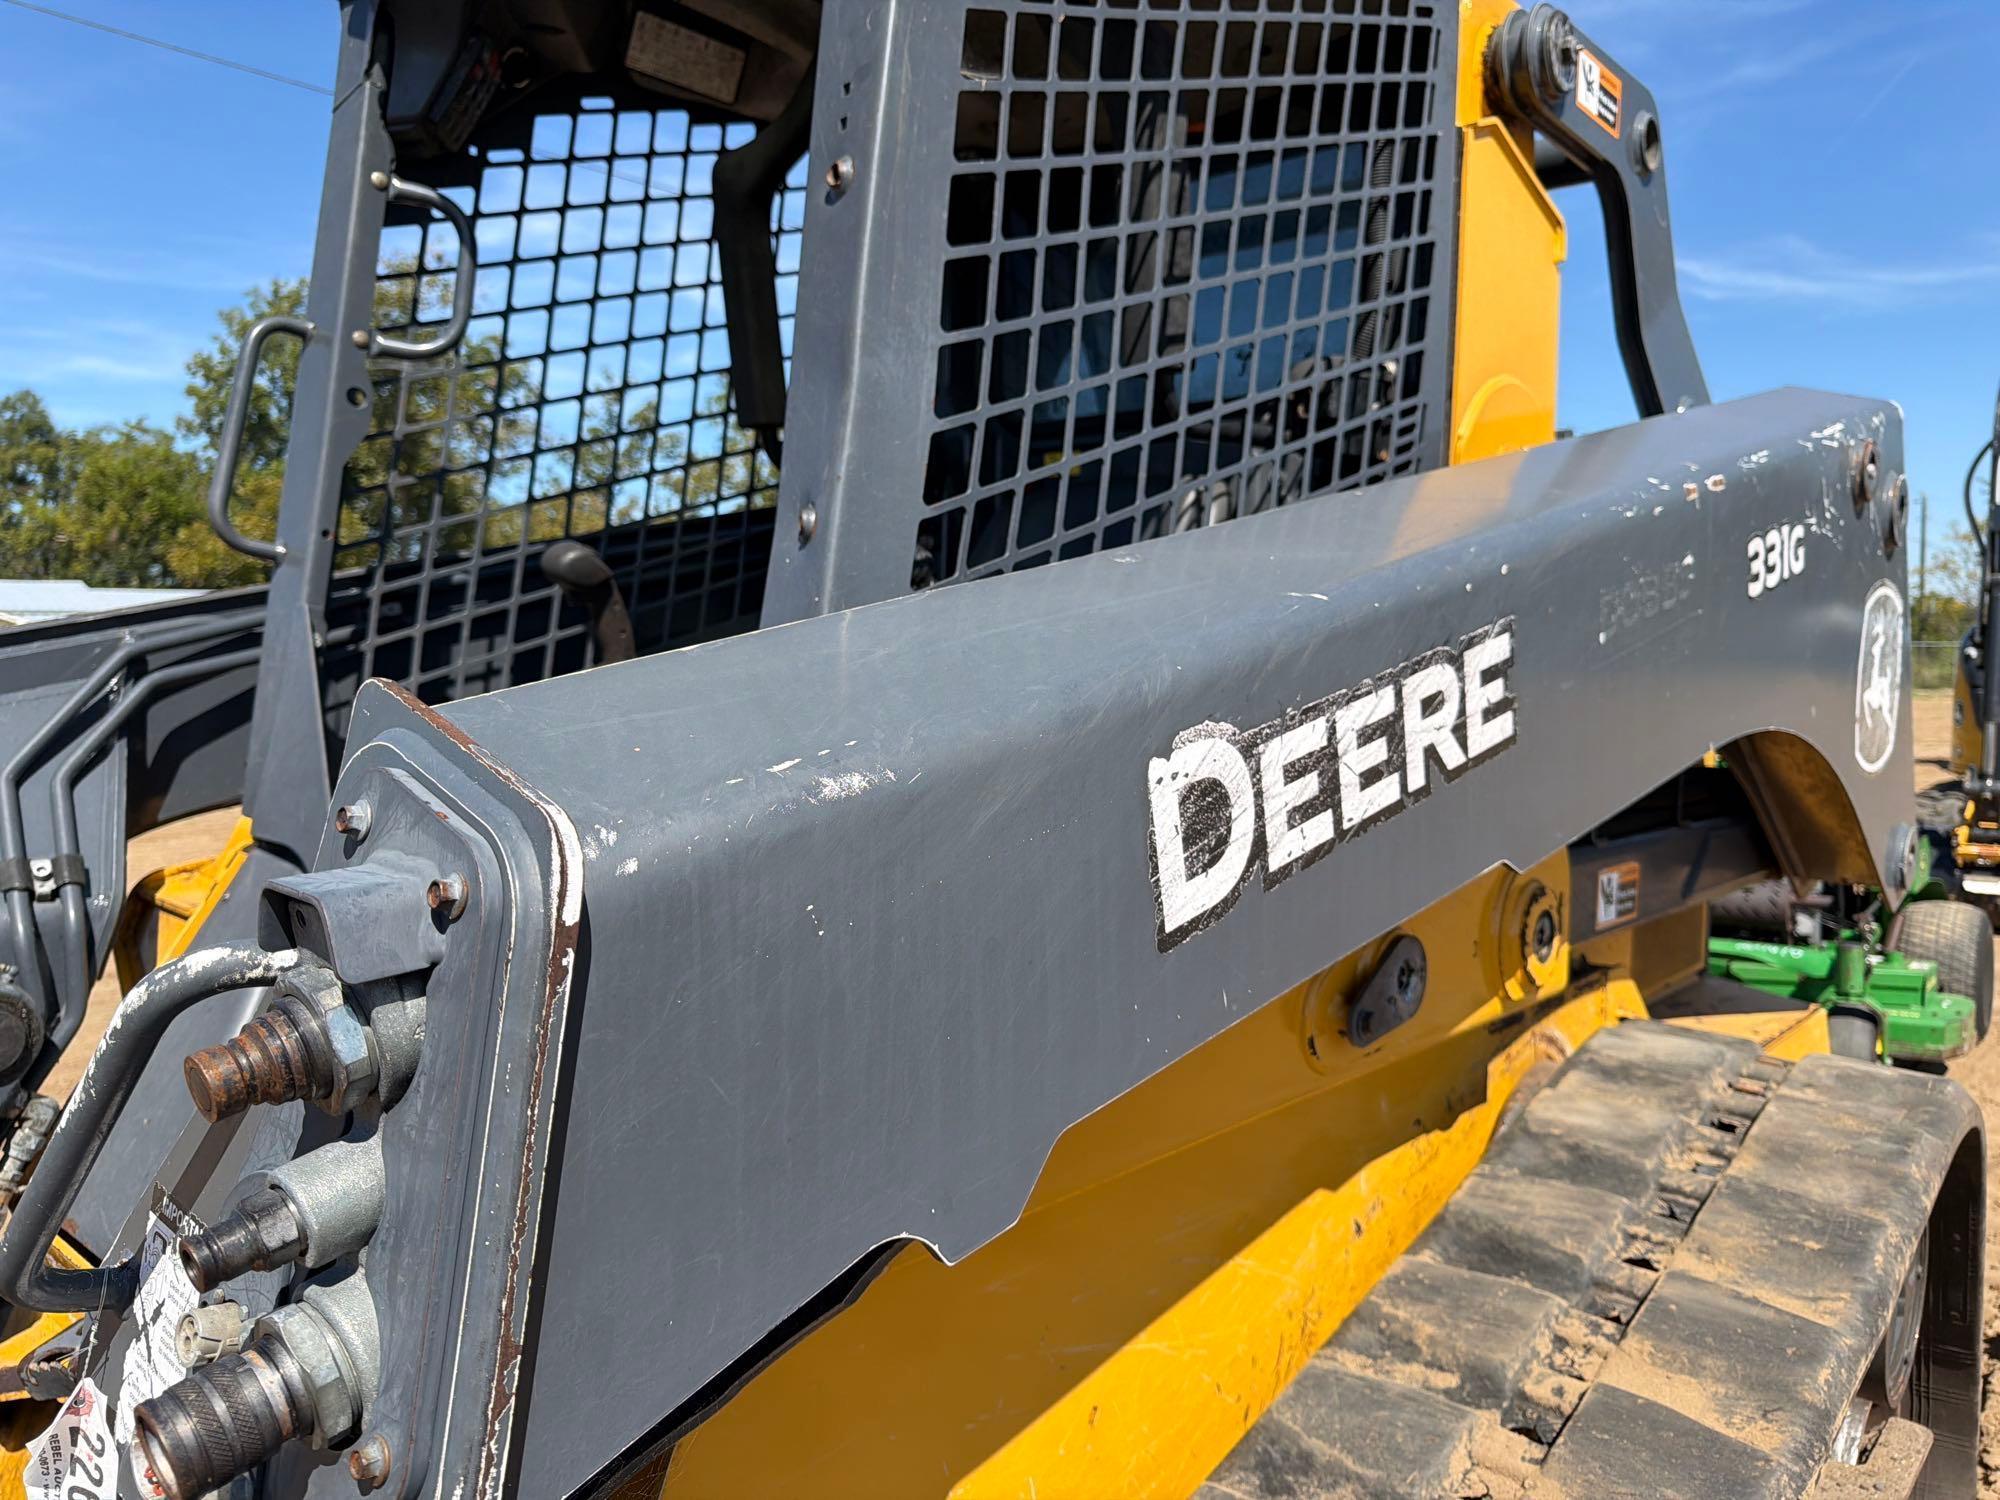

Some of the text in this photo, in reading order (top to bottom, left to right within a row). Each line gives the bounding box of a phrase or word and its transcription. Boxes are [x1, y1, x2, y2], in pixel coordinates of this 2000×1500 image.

[1747, 524, 1805, 598] 331G
[1147, 632, 1516, 936] DEERE
[49, 1434, 62, 1465] REBEL
